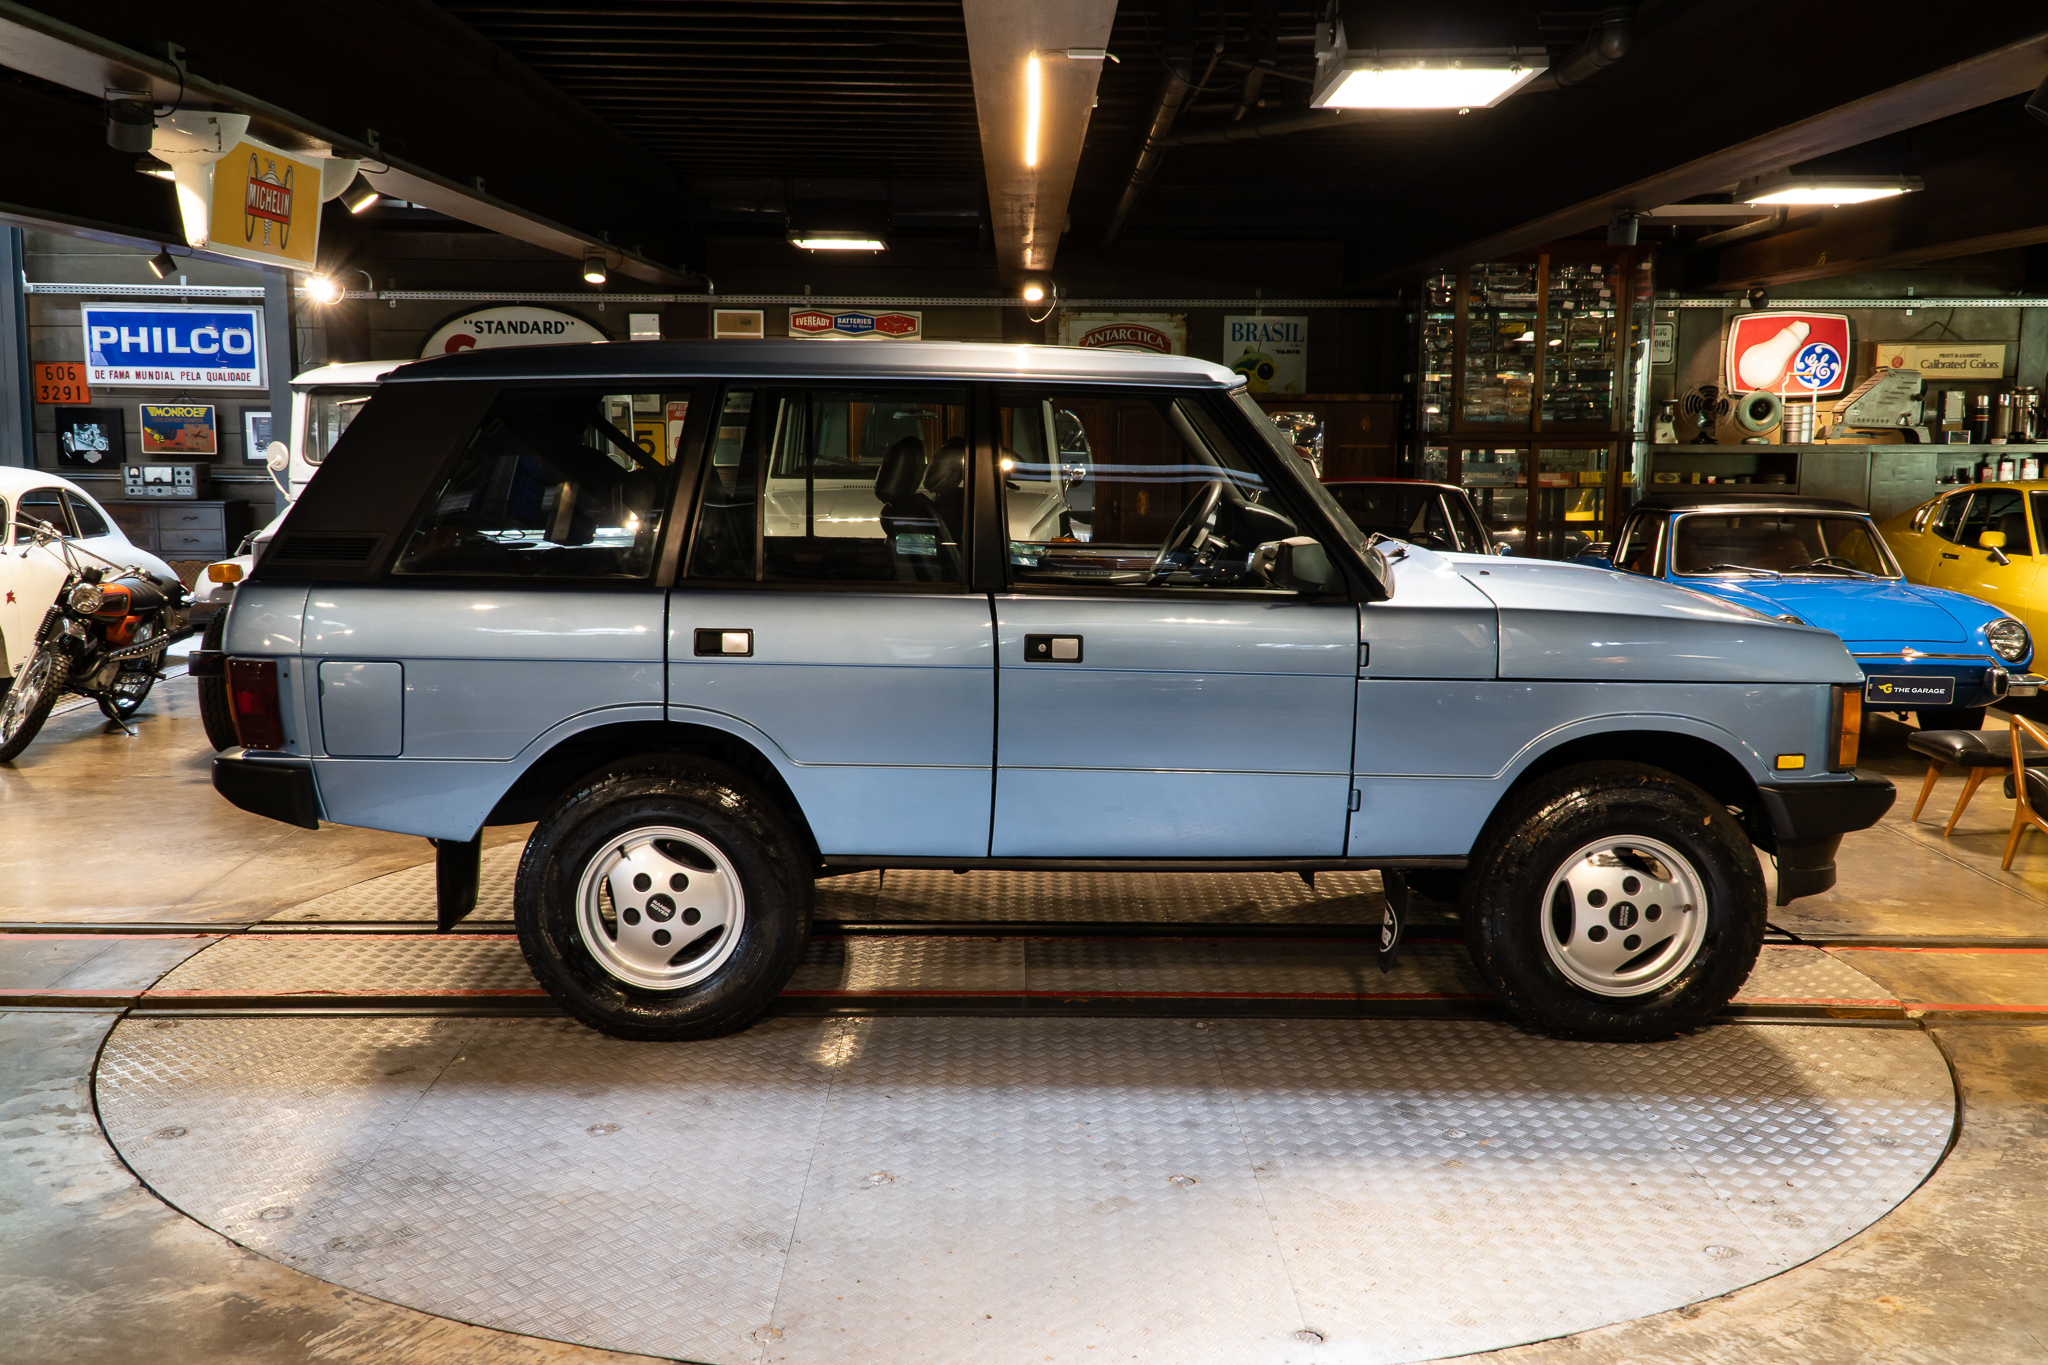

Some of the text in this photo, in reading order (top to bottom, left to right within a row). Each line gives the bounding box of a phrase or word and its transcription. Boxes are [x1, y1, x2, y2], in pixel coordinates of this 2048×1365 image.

[248, 183, 290, 216] MICHELIN
[795, 316, 831, 326] EVEREADY
[837, 317, 872, 325] BATTERIES
[1086, 328, 1165, 348] ANTARCTICA
[1231, 322, 1304, 342] BRASIL
[90, 326, 252, 355] PHILCO
[1920, 359, 1999, 369] Calibrated Colors
[45, 366, 76, 381] 606
[94, 370, 252, 382] DE FAMA MUNDIAL PELA QUALIDADE
[41, 385, 81, 401] 3291
[154, 407, 200, 418] MONROE
[649, 903, 670, 917] ROVER
[652, 899, 672, 914] RANGE
